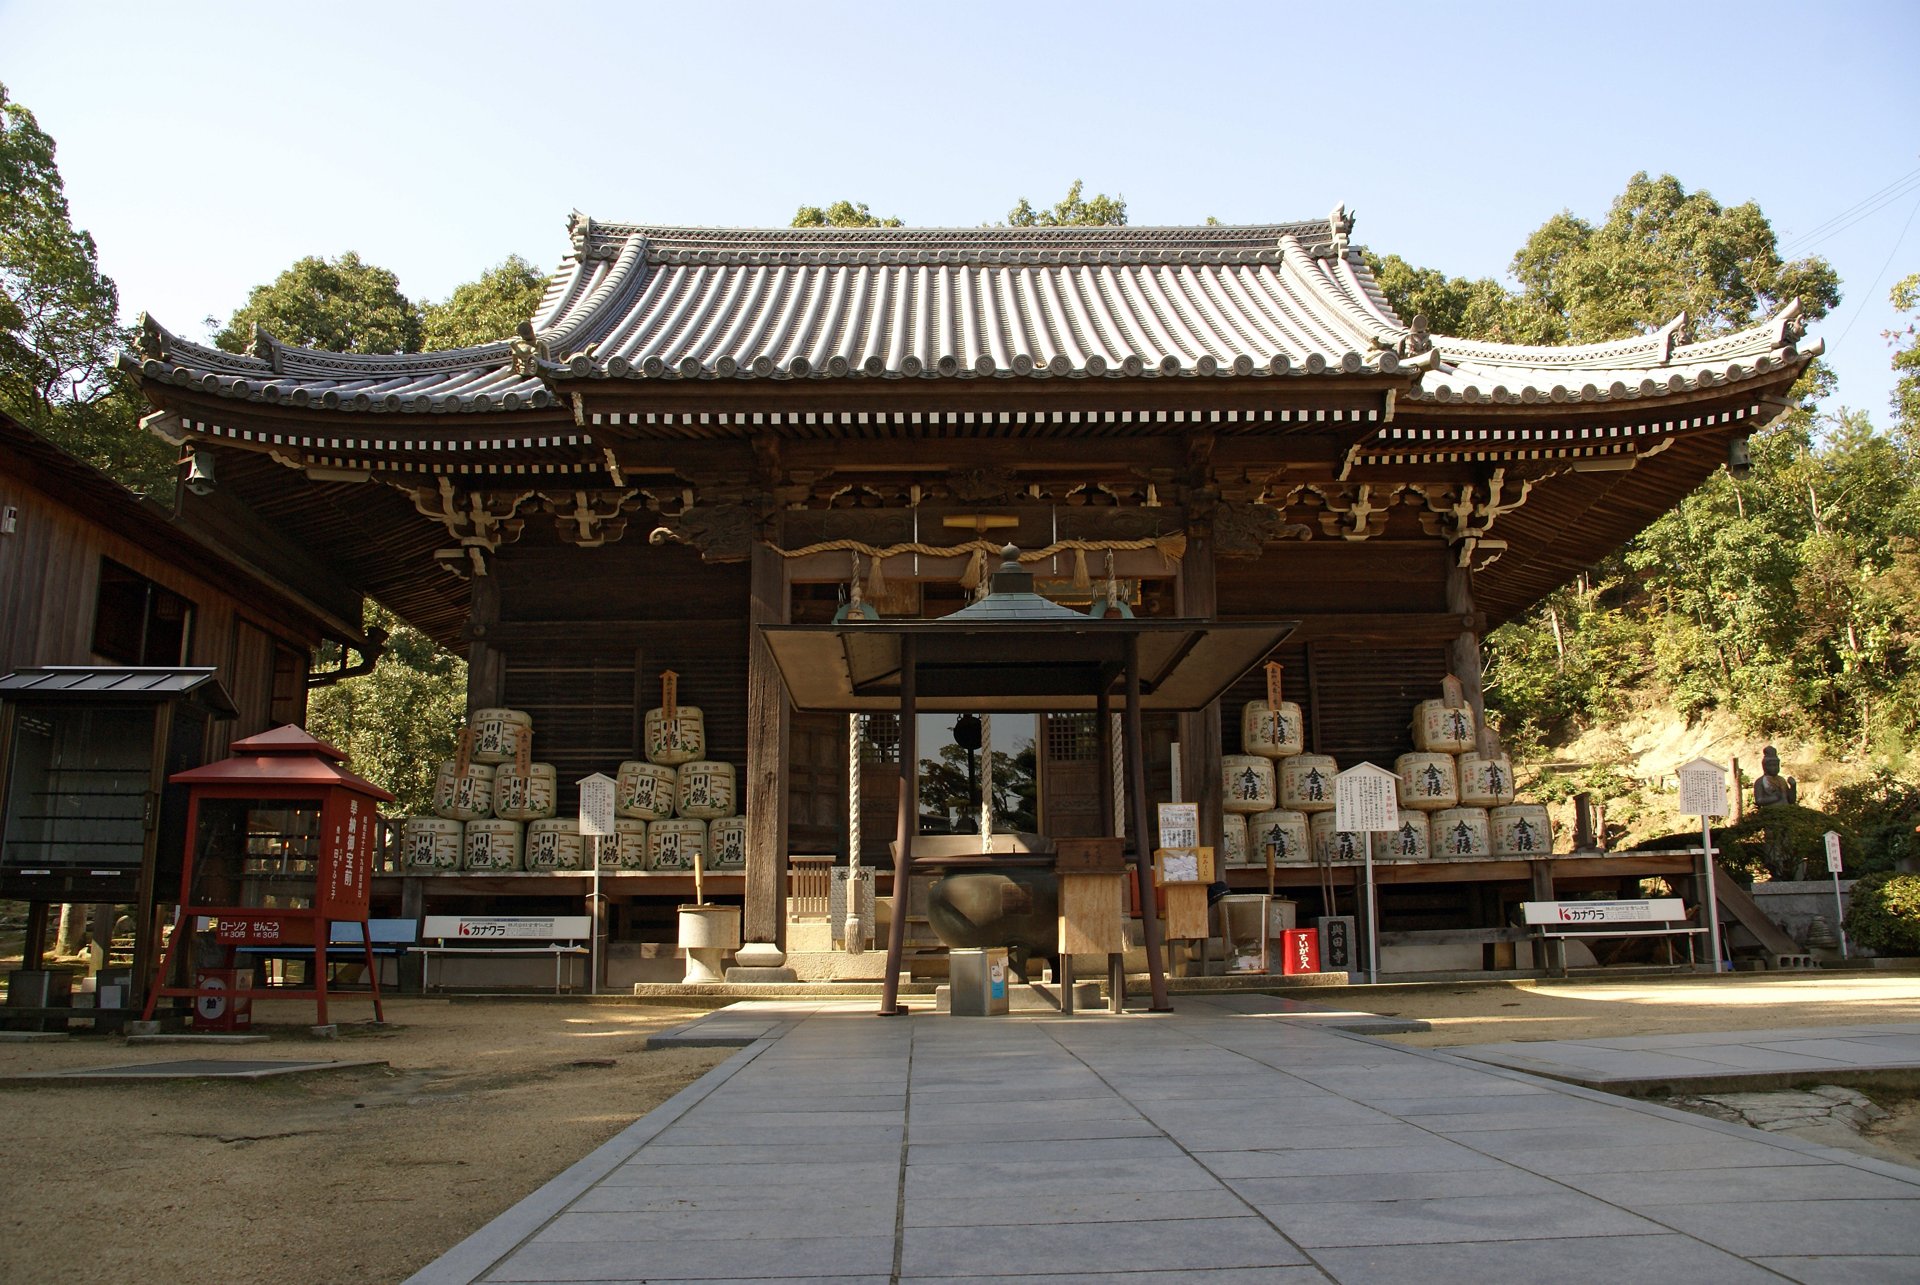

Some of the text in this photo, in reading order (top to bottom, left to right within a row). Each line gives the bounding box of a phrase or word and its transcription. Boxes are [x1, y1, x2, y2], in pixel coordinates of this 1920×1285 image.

[220, 922, 279, 931] ローソク せんこう
[1298, 933, 1310, 970] すいがら入
